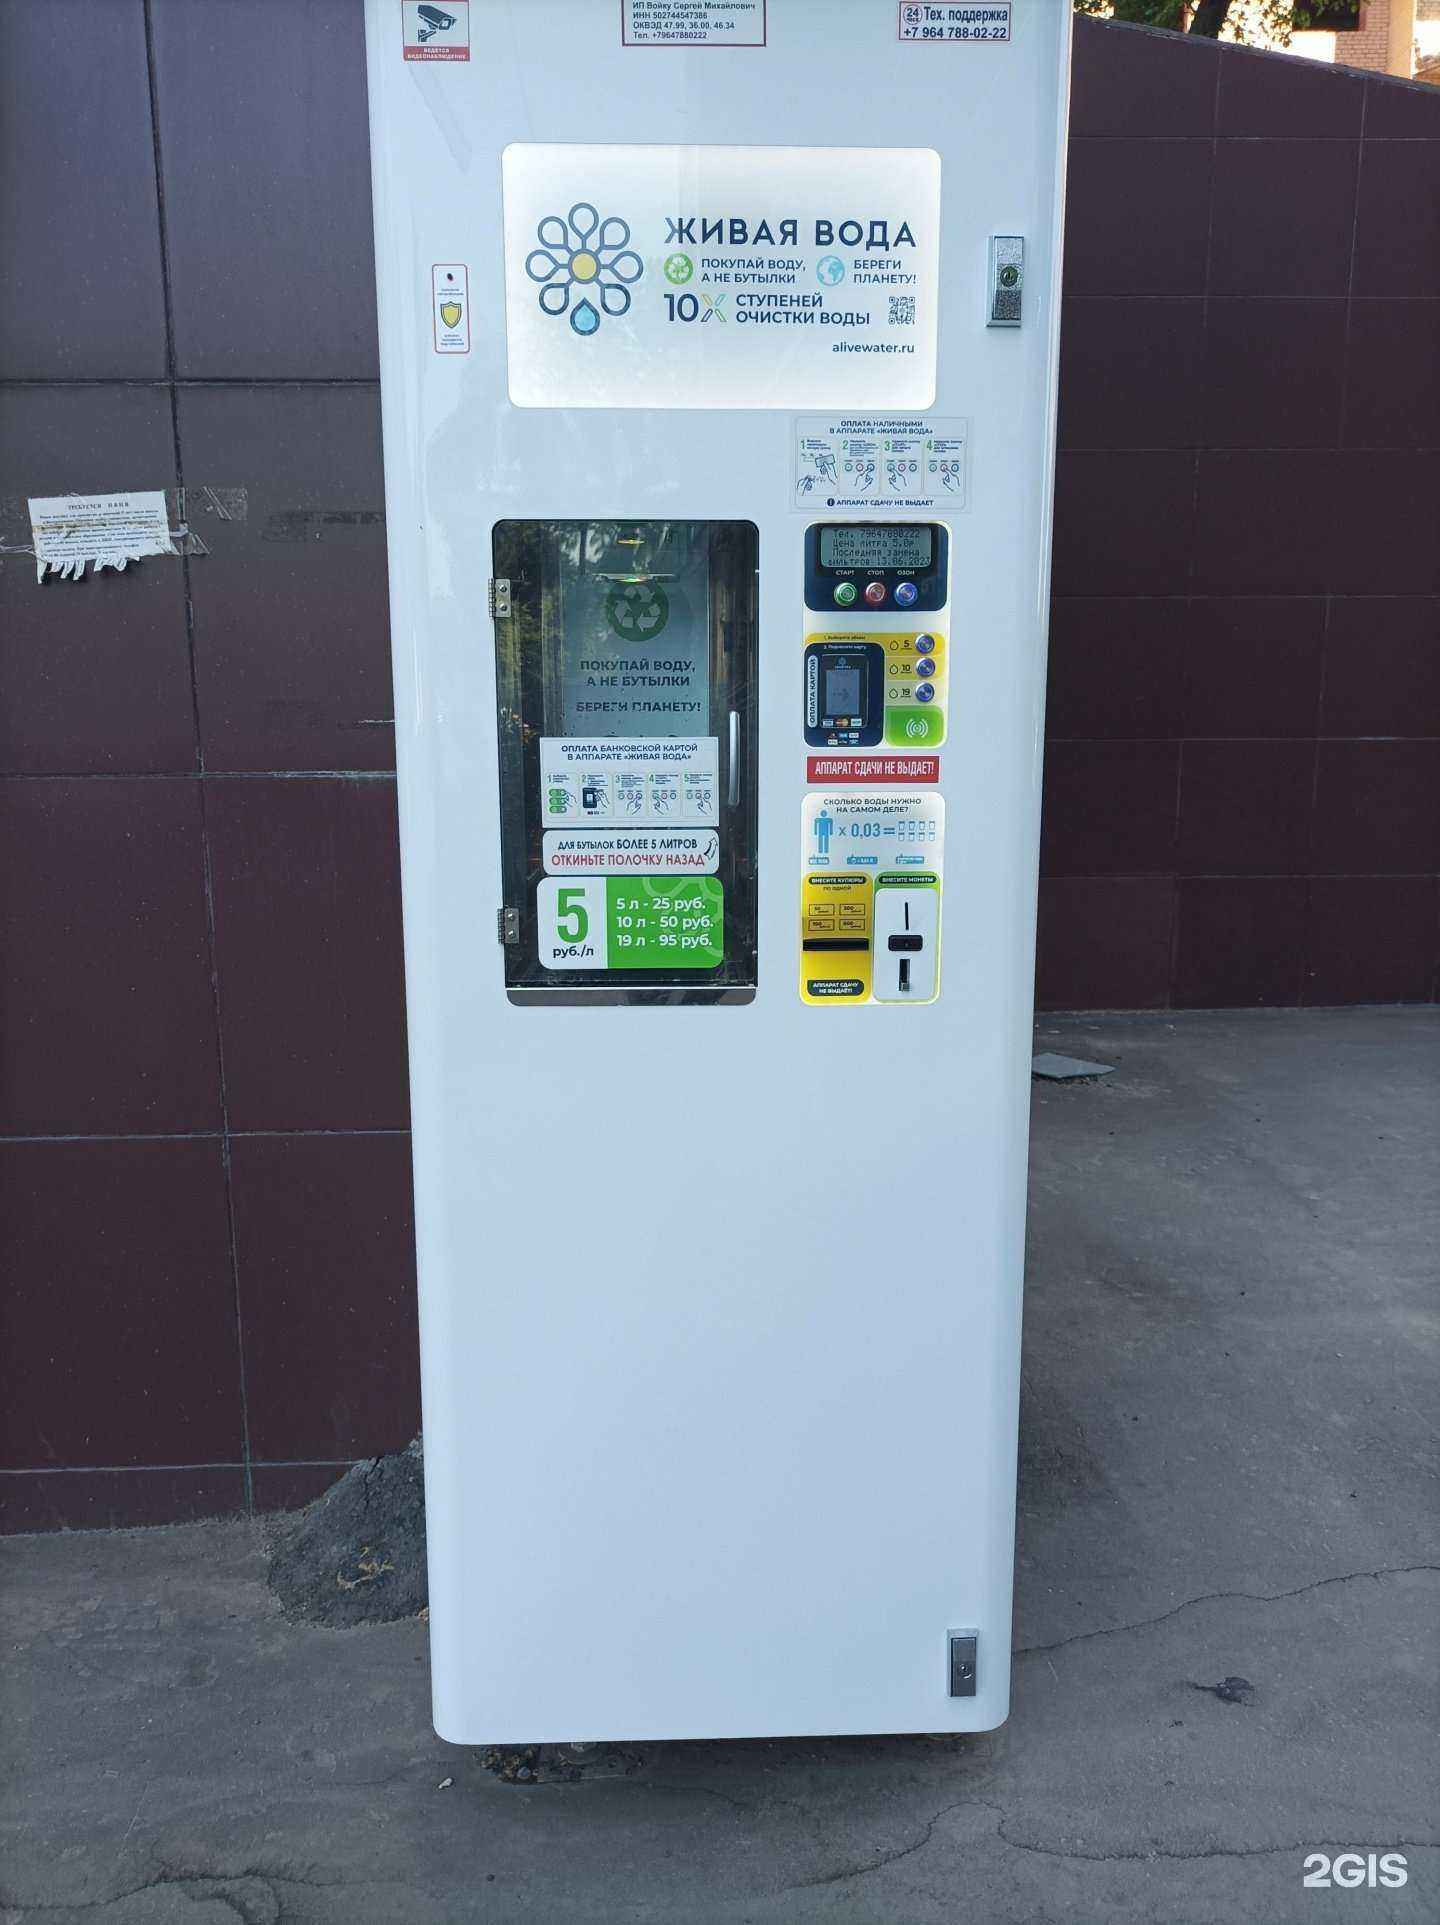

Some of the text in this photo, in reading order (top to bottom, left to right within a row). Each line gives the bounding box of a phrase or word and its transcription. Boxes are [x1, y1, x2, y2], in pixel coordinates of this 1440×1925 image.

[647, 0, 671, 11] Войку
[674, 1, 702, 11] Сергей
[704, 1, 756, 10] Михайлович
[906, 8, 919, 18] 24
[924, 6, 1008, 24] Тех. поддержка
[633, 22, 663, 30] ОКВЭД
[904, 27, 1007, 38] +7 964 788-02-22
[664, 217, 916, 251] ЖИВАЯ ВОДА
[702, 257, 806, 272] ПОКУПАЙ ВОДУ,
[854, 260, 902, 270] БЕРЕГИ
[702, 274, 796, 284] А НЕ БУТЫЛКИ
[854, 274, 917, 284] ПЛАНЕТУ!
[736, 292, 824, 308] СТУПЕНЕЙ
[736, 310, 870, 327] ОЧИСТКИ ВОДЫ
[832, 342, 915, 354] alivewater.ru
[842, 440, 848, 450] 2
[884, 440, 890, 450] 3
[926, 440, 934, 450] 4
[904, 640, 910, 648] 5
[580, 658, 696, 672] ПОКУПАЙ ВОДУ,
[587, 676, 690, 686] А НЕ БУТЫЛКИ
[576, 702, 628, 712] БЕРЕГИ
[600, 744, 662, 752] БАНКОВСКОЙ
[664, 744, 698, 752] КАРТОЙ
[815, 761, 934, 776] АППАРАТ СДАЧИ НЕ ВЫДАЕТ!
[851, 823, 881, 838] 0.03
[558, 838, 698, 850] ДЛЯ БУТЫЛОК БОЛЕЕ 5 ЛИТРОВ
[552, 854, 705, 866] ОТКИНЬТЕ ПОЛОЧКУ НАЗАД
[616, 898, 626, 910] 5
[629, 902, 639, 910] л
[652, 898, 670, 909] 25
[674, 897, 706, 912] руб.
[557, 888, 588, 944] 5
[616, 916, 632, 928] 10
[636, 920, 646, 928] л
[660, 916, 678, 928] 50
[682, 916, 714, 931] руб.
[616, 934, 632, 946] 19
[636, 938, 646, 946] л
[659, 934, 678, 946] 95
[682, 934, 713, 949] руб.
[553, 945, 594, 958] руб./л
